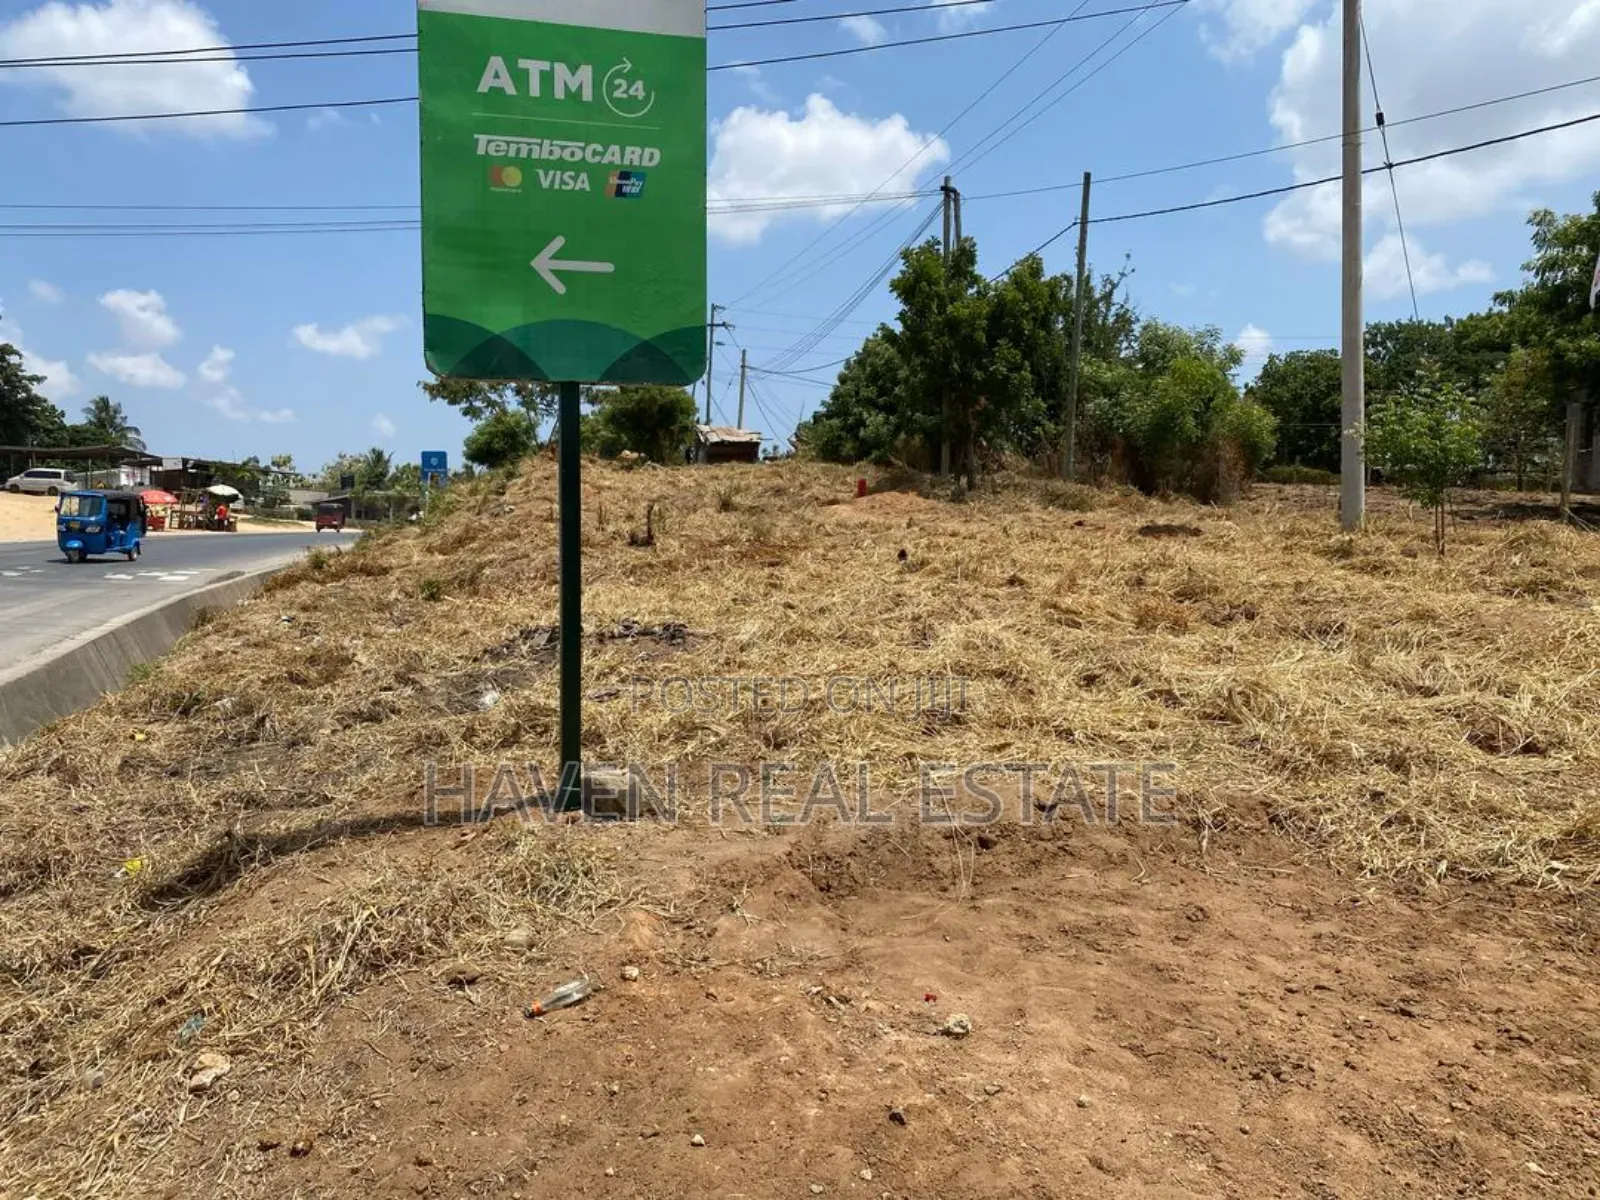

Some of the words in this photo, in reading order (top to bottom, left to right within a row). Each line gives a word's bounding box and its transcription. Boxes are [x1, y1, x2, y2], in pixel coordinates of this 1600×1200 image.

[476, 55, 593, 102] ATM
[612, 78, 646, 100] 24
[533, 168, 592, 192] VISA
